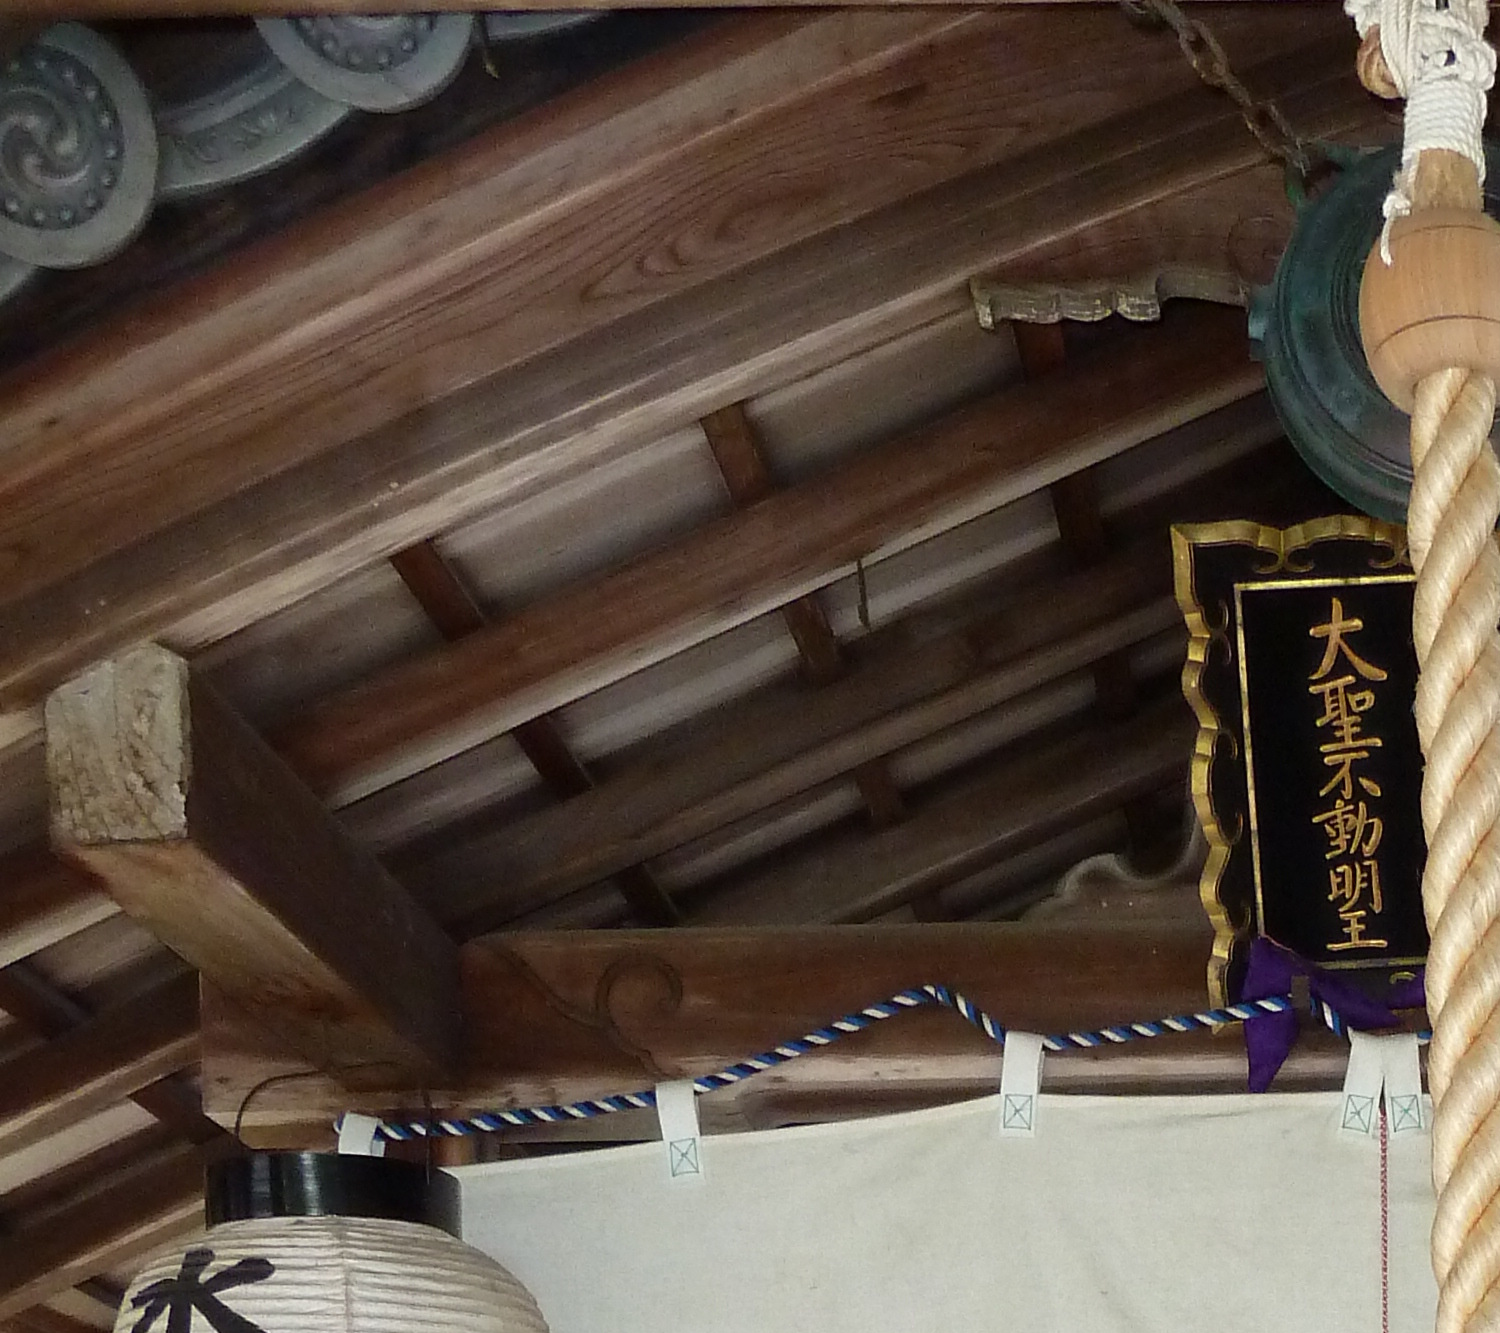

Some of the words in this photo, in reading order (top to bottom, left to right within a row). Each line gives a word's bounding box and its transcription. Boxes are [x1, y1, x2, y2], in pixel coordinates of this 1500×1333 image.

[1309, 597, 1388, 951] 大聖不動明王
